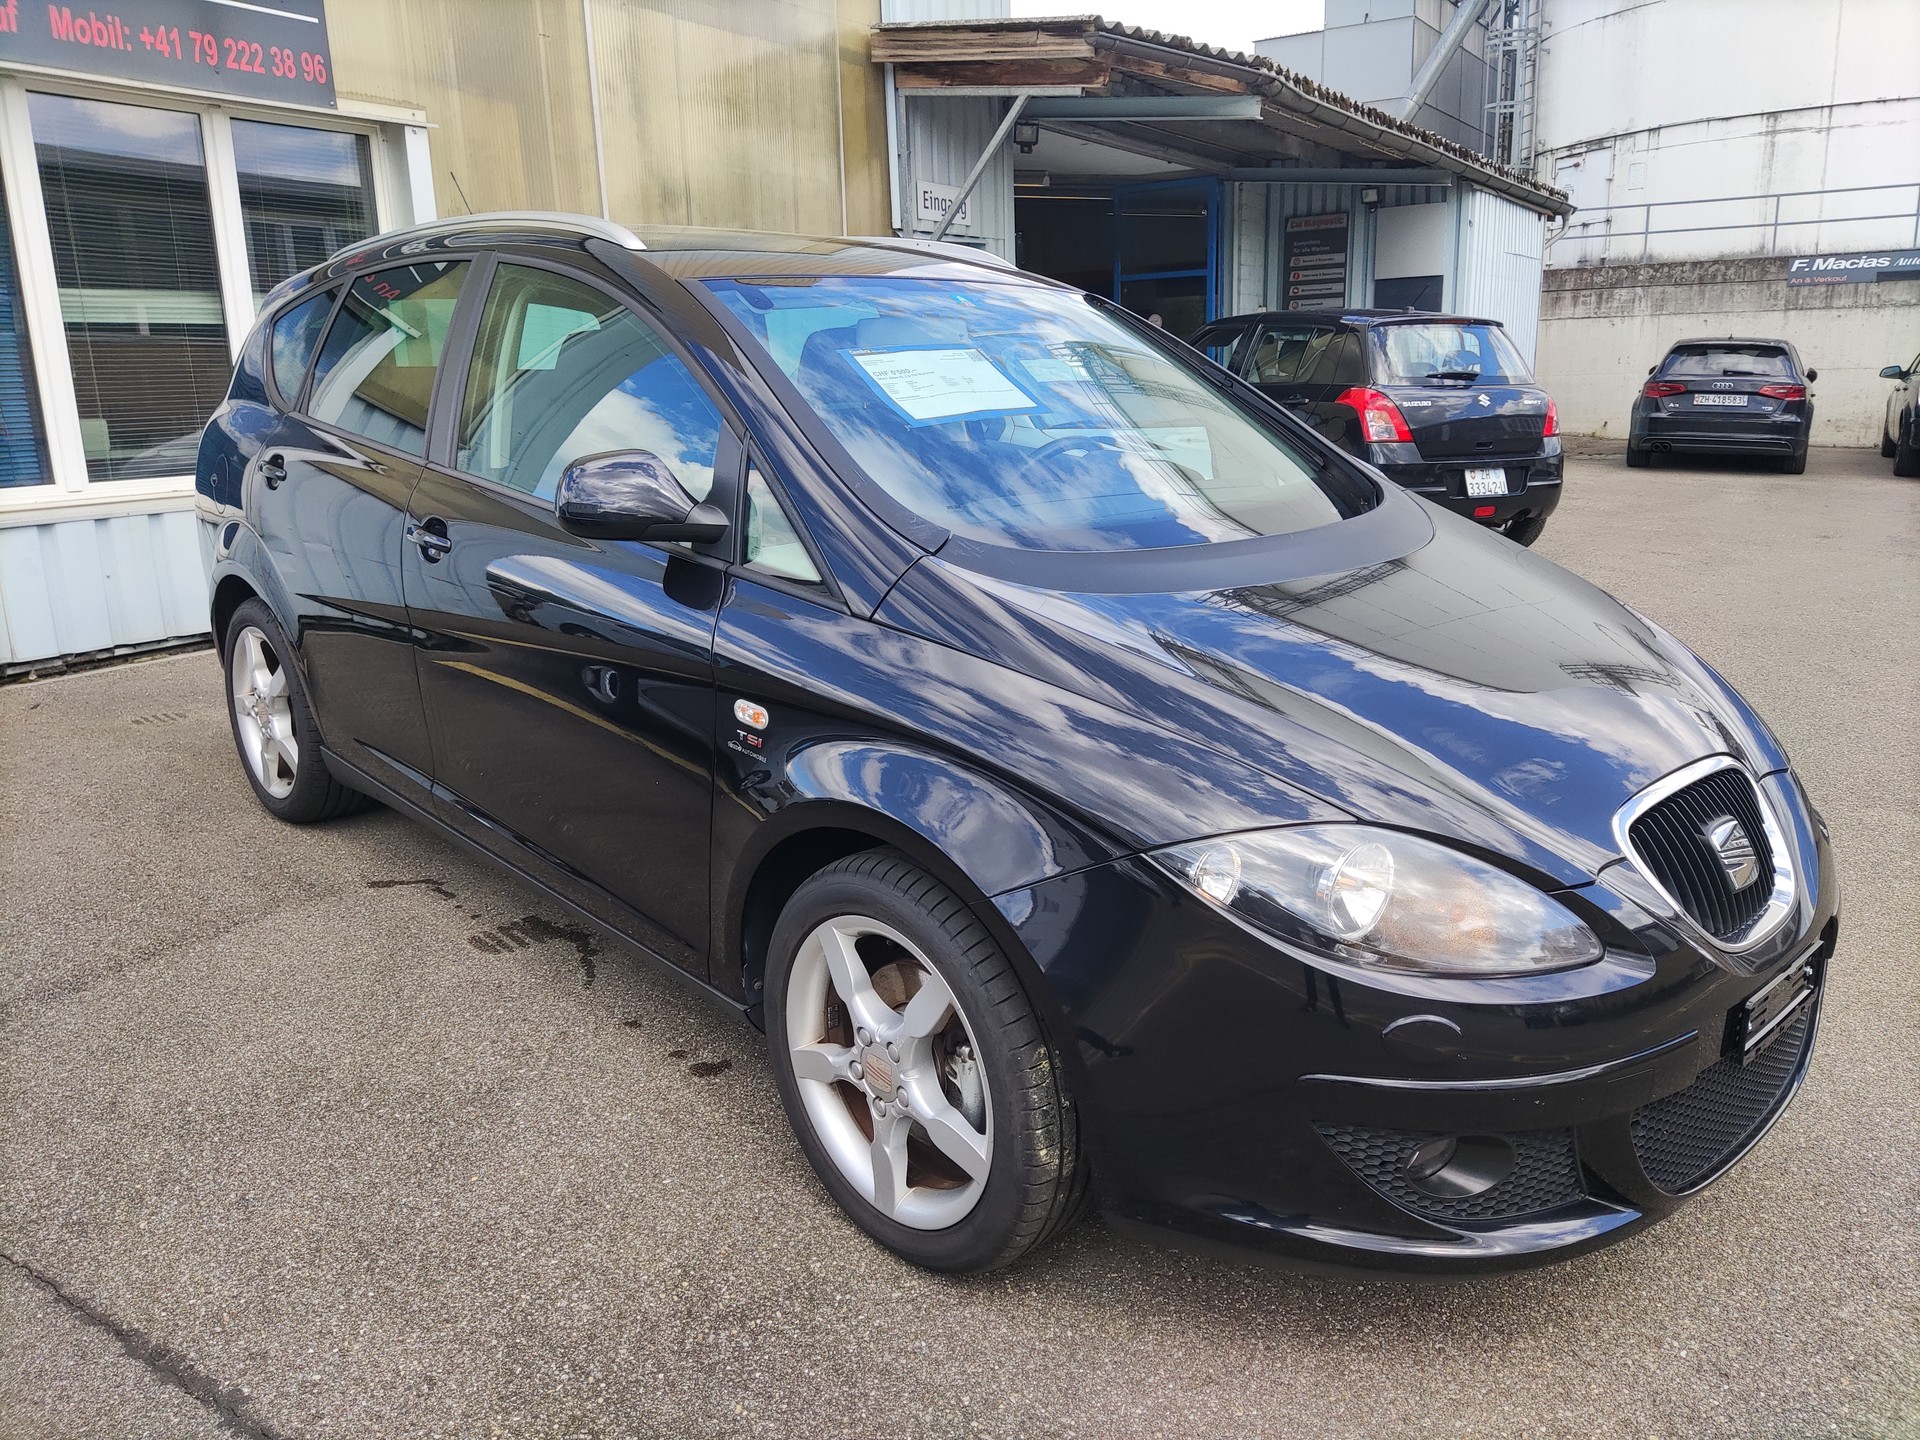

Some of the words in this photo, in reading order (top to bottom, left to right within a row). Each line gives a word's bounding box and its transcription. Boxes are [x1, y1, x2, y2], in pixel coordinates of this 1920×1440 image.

[48, 4, 132, 51] Mobil:
[139, 24, 182, 60] +41
[188, 30, 218, 66] 79
[224, 37, 265, 75] 222
[270, 46, 297, 79] 38
[300, 51, 327, 84] 96
[923, 190, 967, 220] Eingag
[1812, 256, 1891, 270] Macias
[1813, 275, 1848, 283] Verkauf
[1480, 469, 1491, 480] ZH
